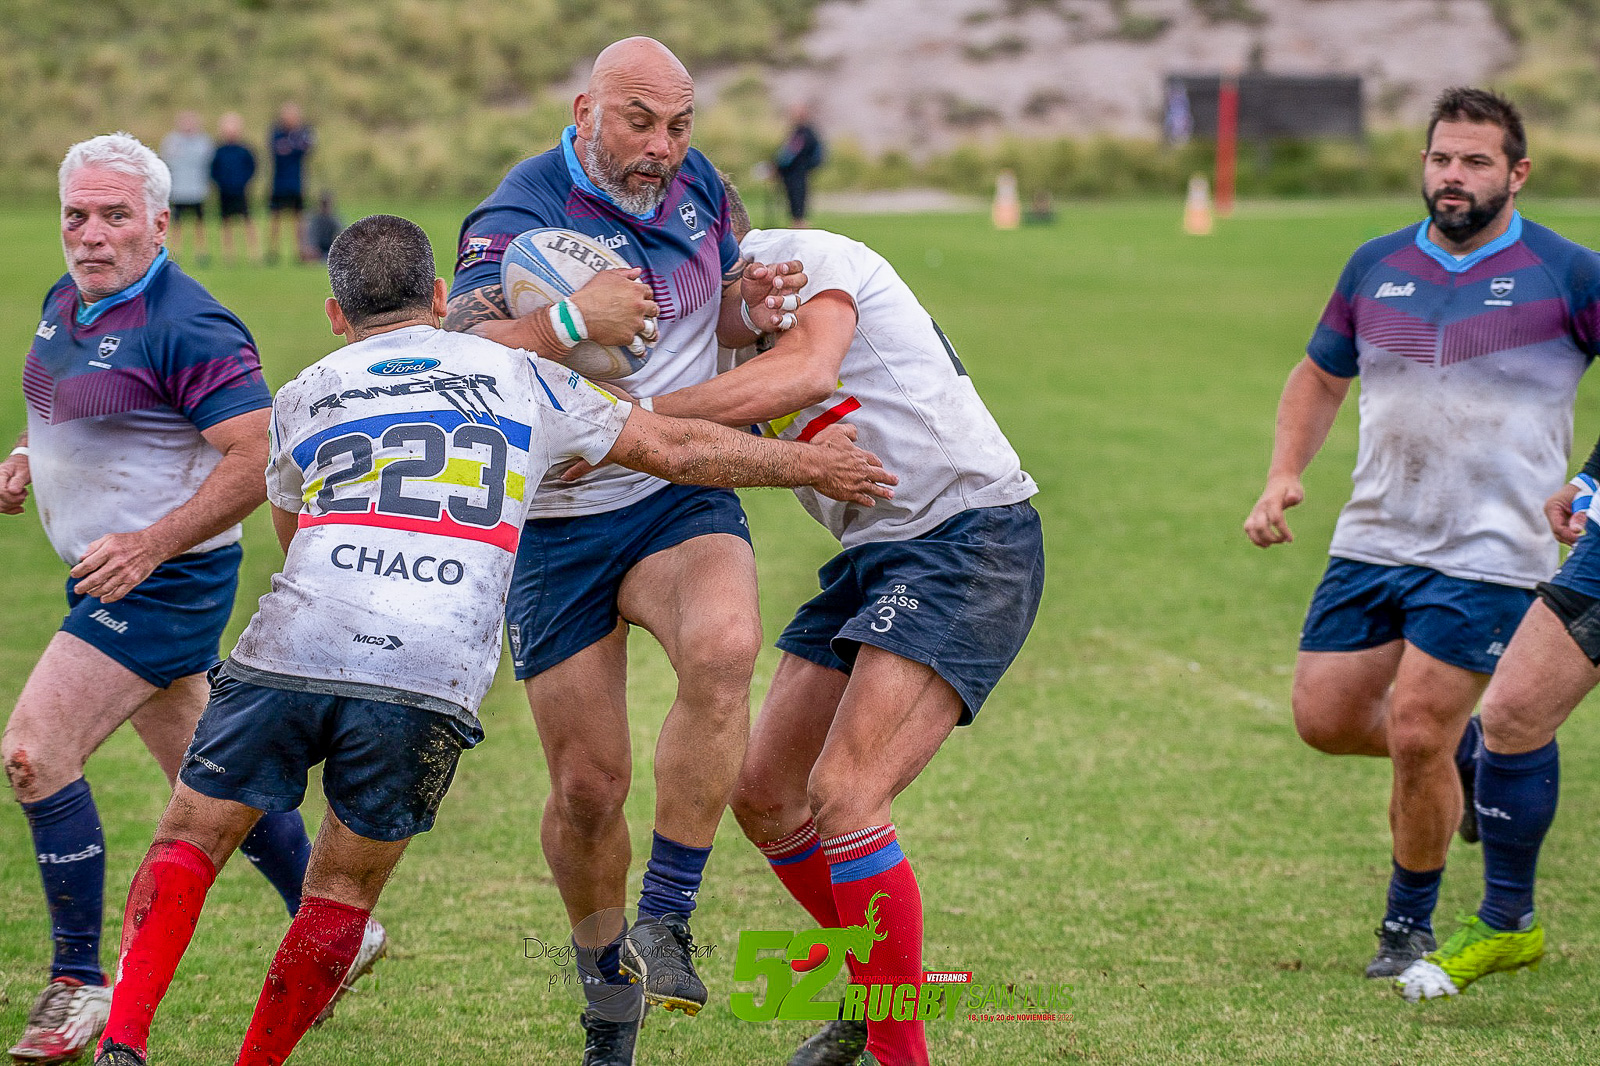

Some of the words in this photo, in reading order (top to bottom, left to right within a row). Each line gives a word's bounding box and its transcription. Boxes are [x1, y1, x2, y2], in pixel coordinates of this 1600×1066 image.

[309, 373, 505, 419] RANGER
[315, 422, 509, 530] 223
[330, 543, 465, 586] CHACO
[352, 633, 386, 646] MC3
[870, 605, 896, 633] 3
